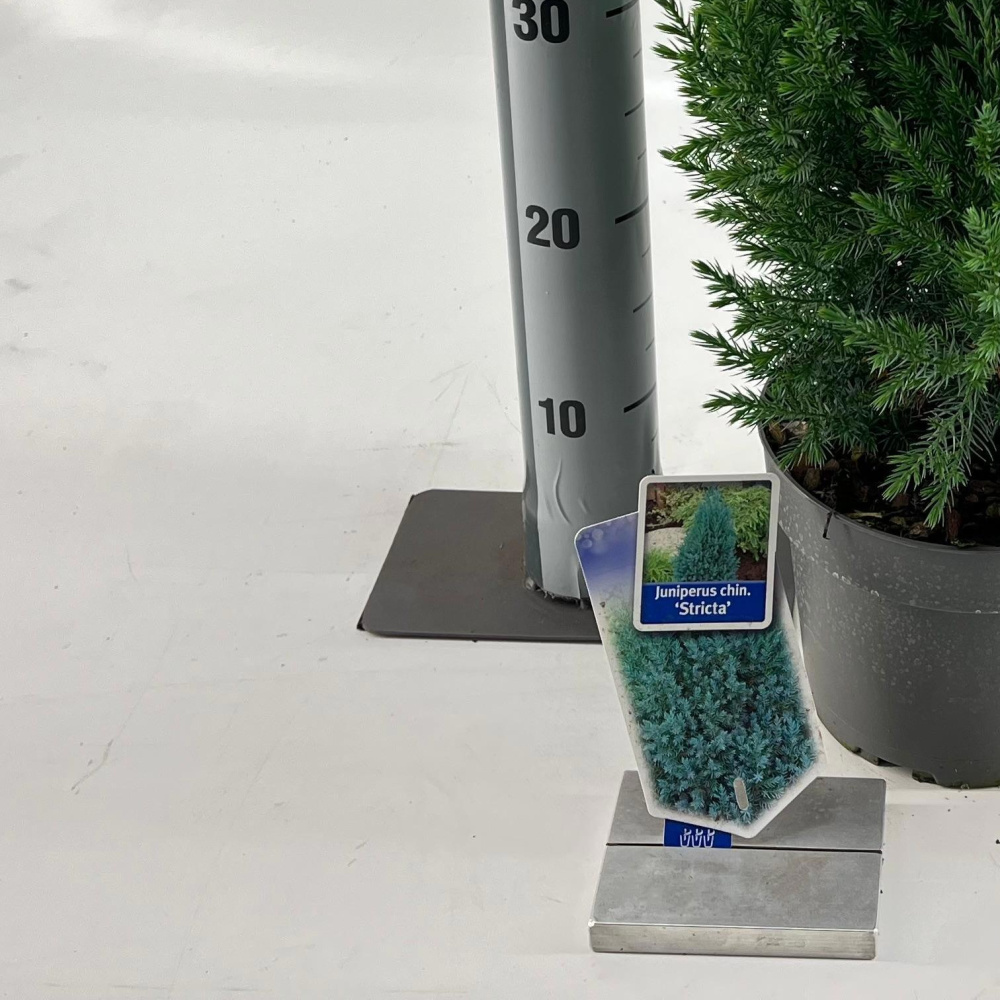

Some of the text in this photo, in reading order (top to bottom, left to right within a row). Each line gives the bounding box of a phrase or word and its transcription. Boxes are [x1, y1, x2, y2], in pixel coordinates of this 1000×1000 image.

[525, 204, 580, 249] 20
[538, 397, 586, 438] 10
[655, 583, 751, 600] Juniperus chin.
[675, 601, 730, 615] ‘Stricta’
